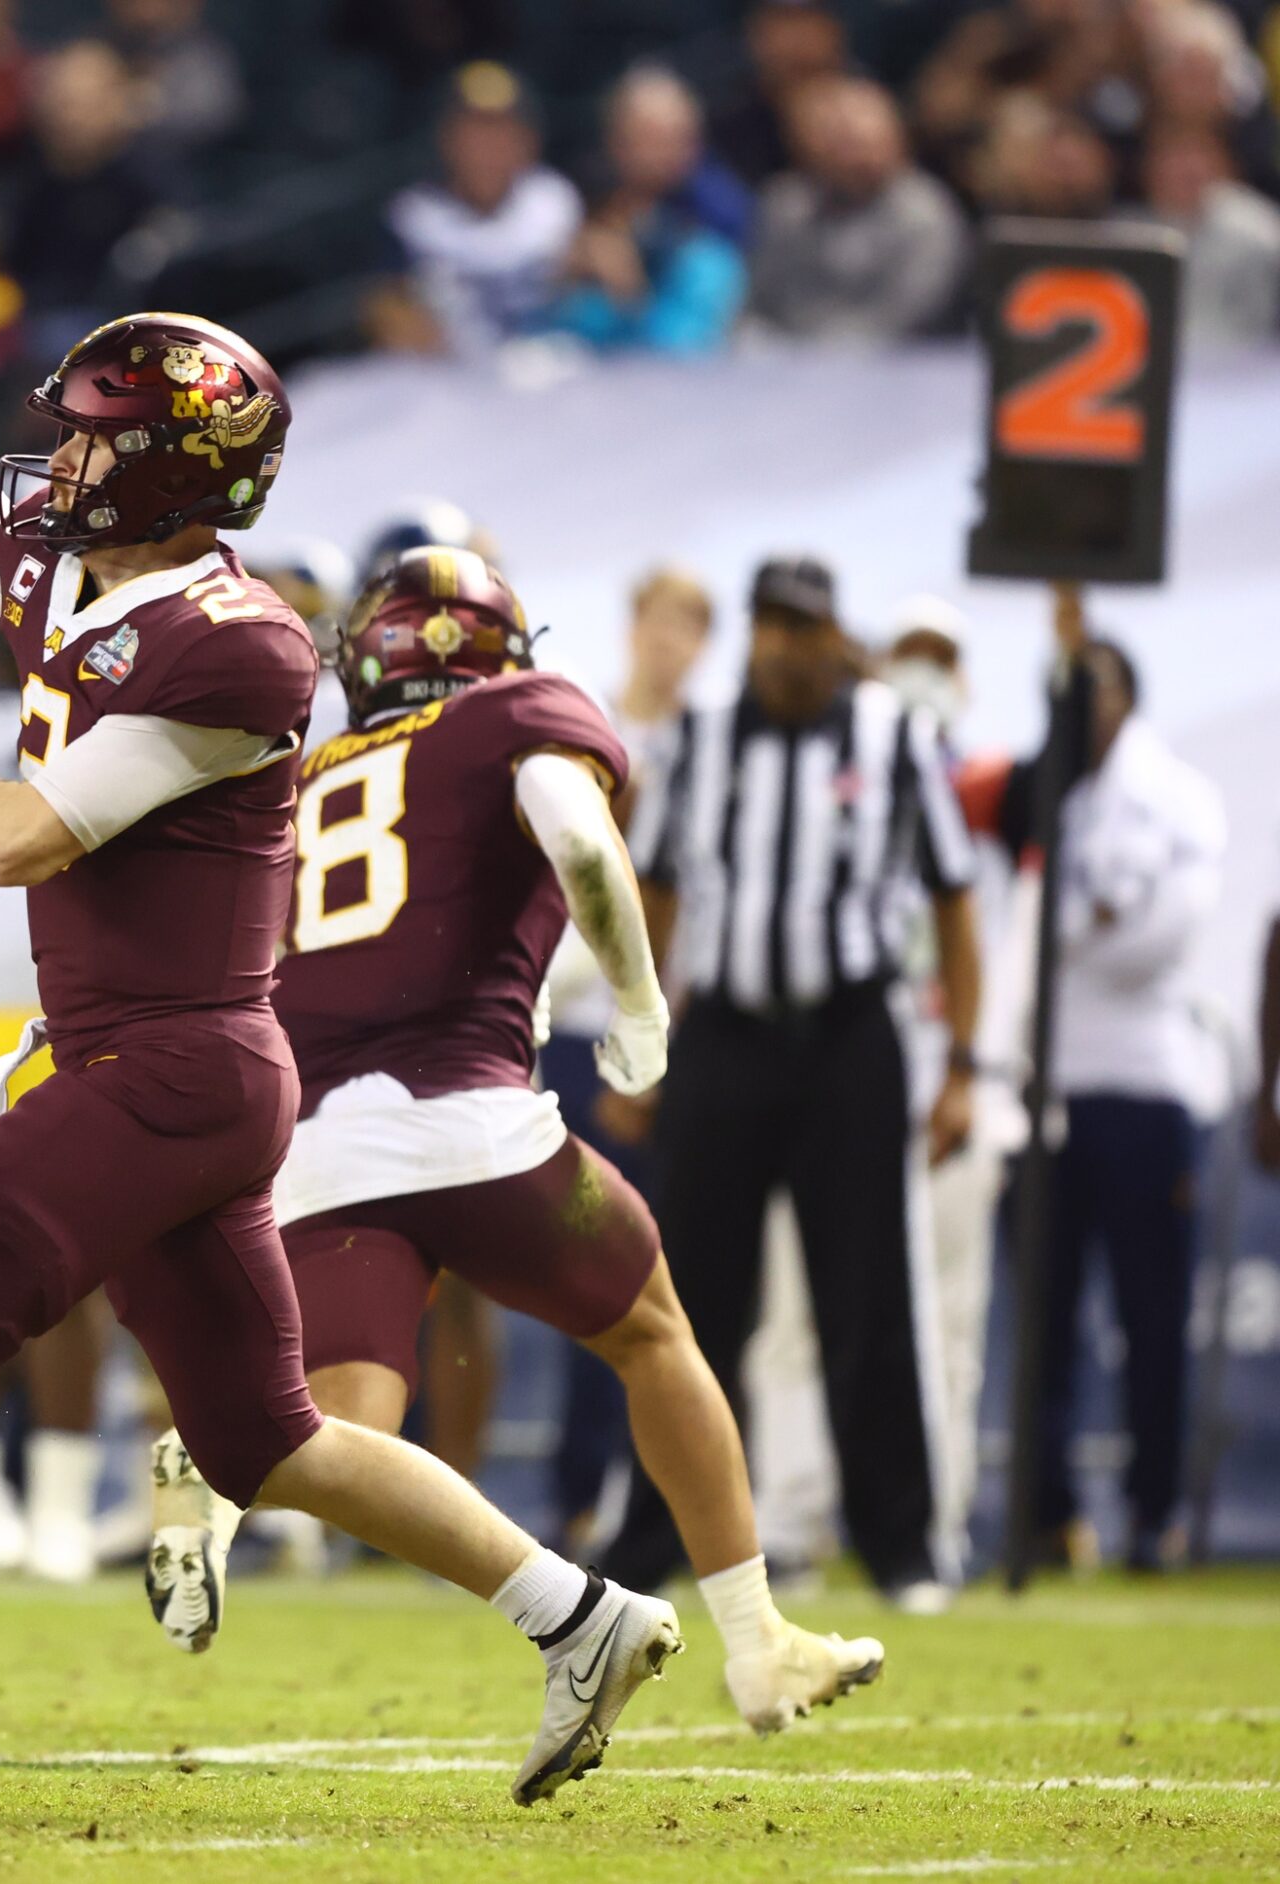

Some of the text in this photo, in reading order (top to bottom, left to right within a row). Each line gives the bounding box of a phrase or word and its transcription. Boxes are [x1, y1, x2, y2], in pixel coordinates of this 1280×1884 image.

[997, 266, 1150, 463] 2
[172, 388, 212, 419] M
[11, 557, 45, 601] C
[185, 574, 265, 625] 2
[293, 738, 412, 953] 8
